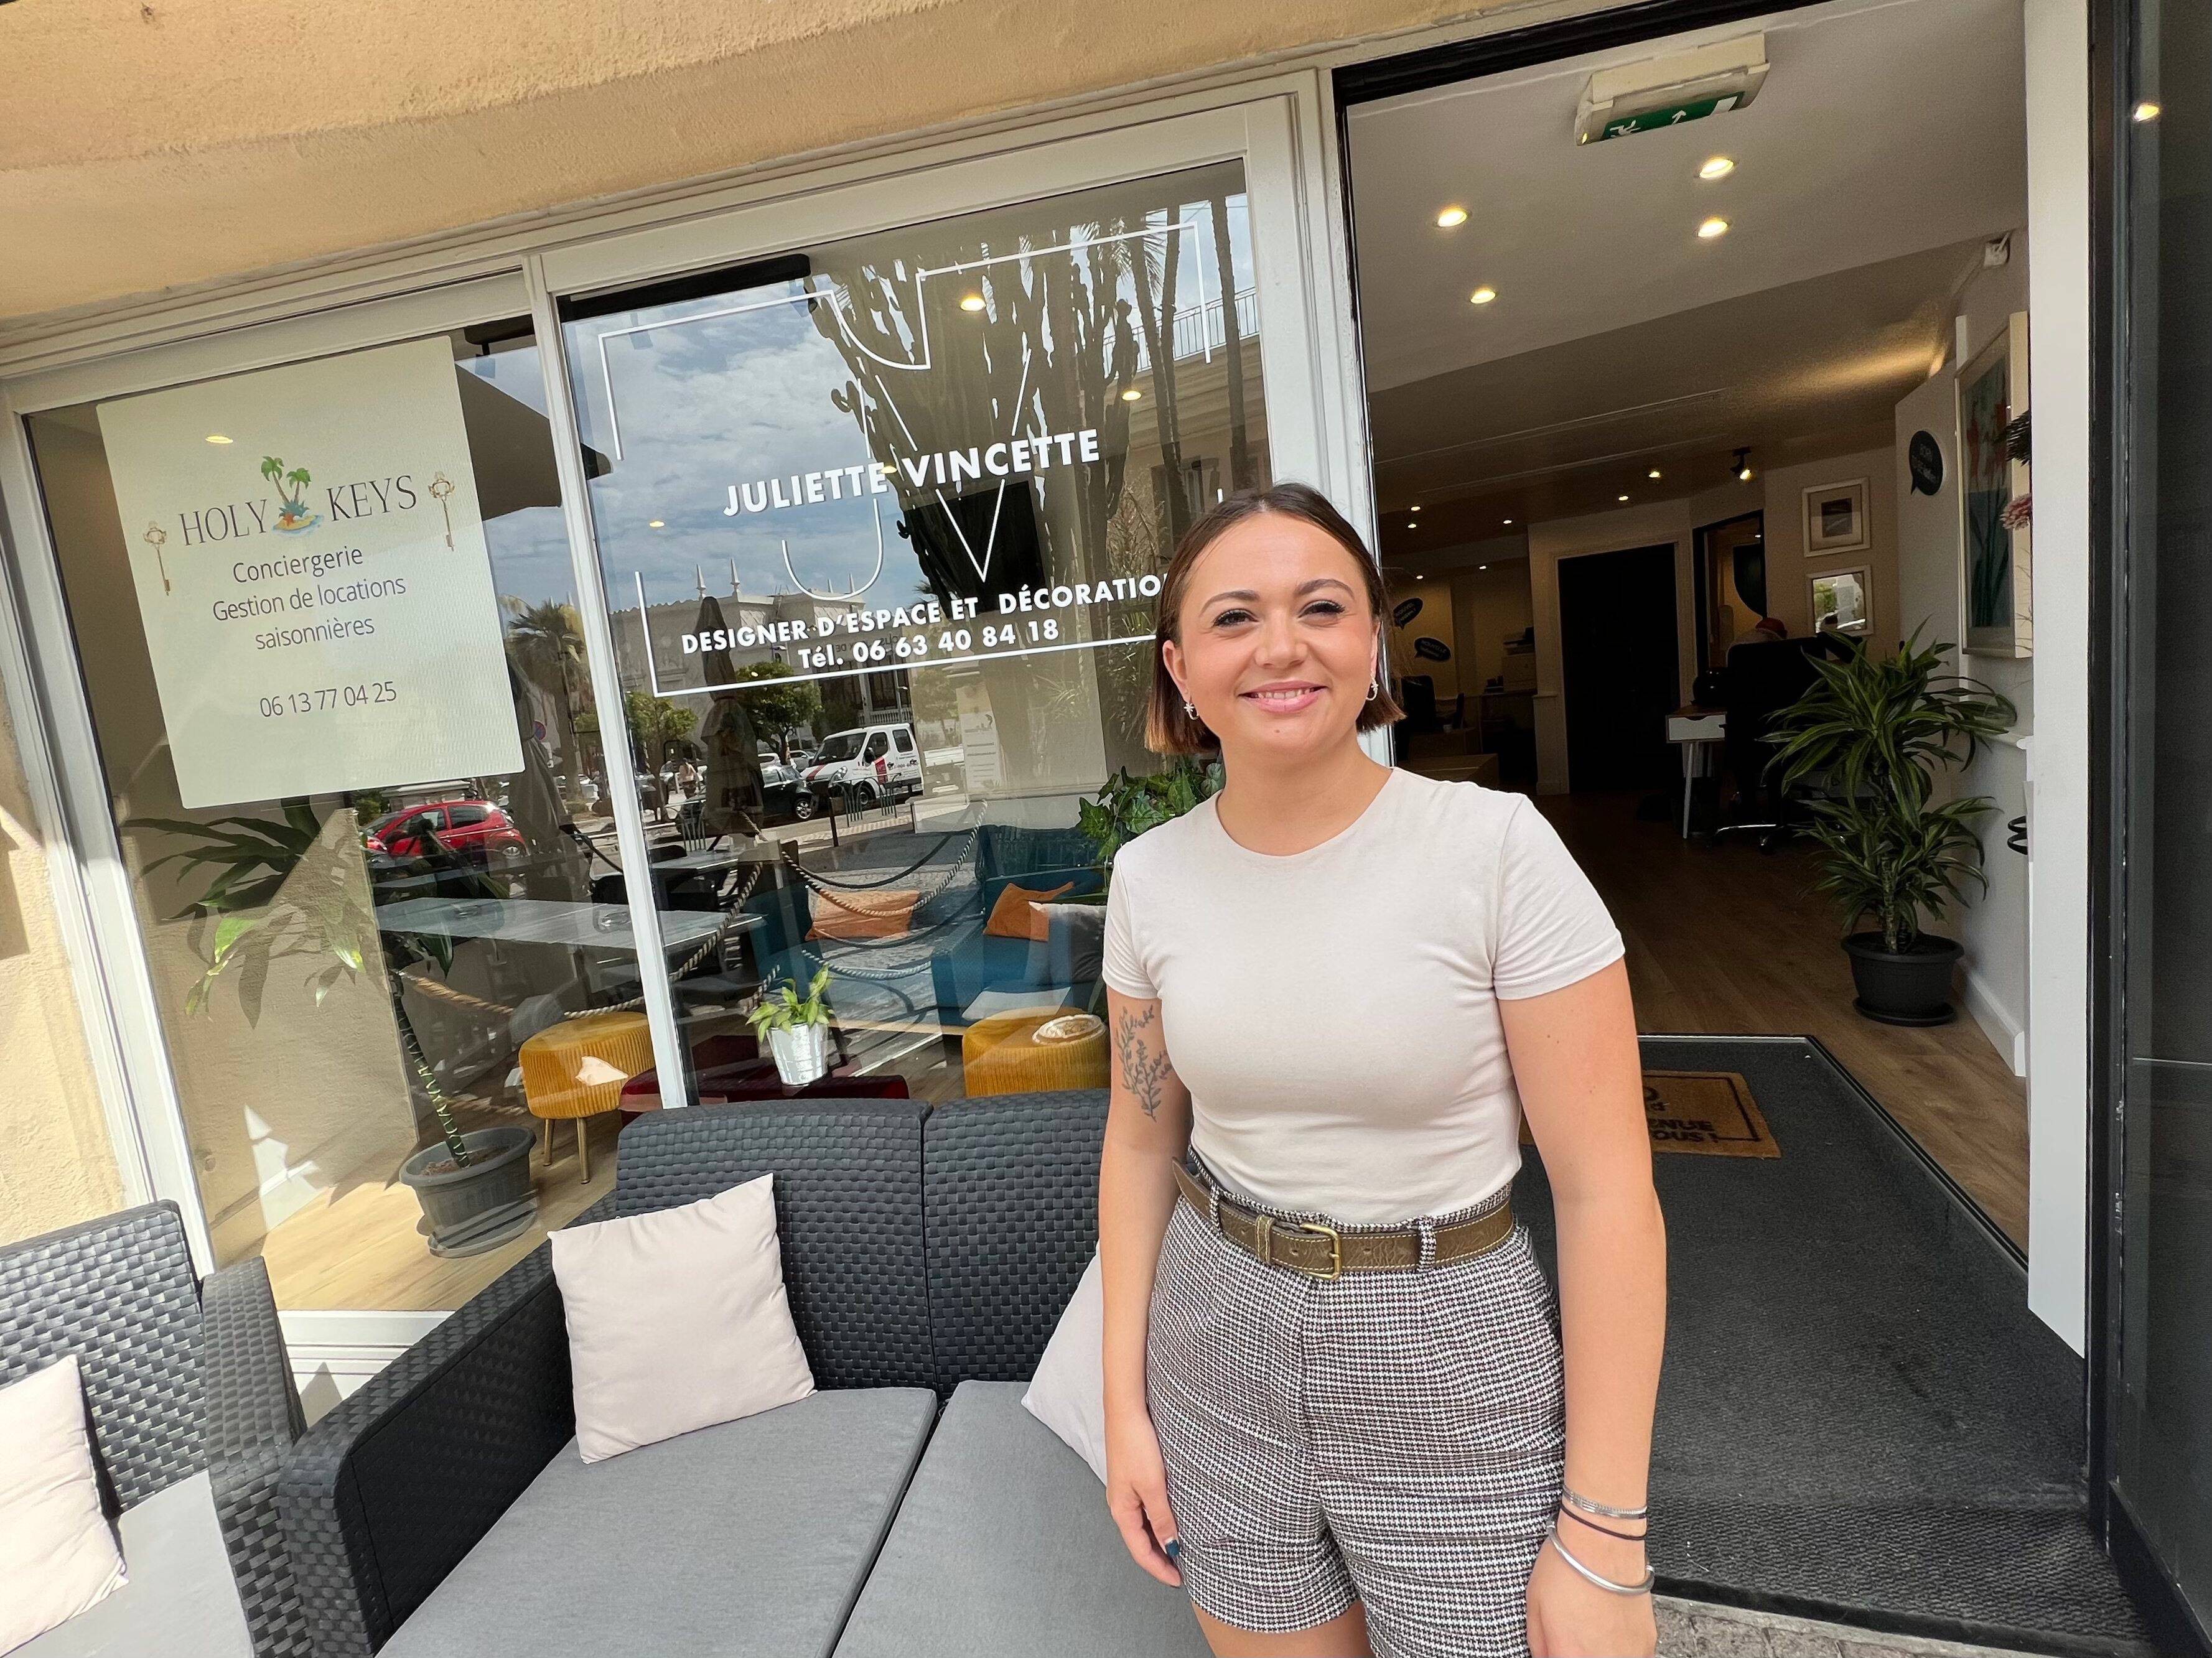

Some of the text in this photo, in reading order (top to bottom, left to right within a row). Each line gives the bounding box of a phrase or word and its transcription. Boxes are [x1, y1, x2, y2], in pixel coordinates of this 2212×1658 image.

[722, 429, 1099, 516] JULIETTE VINCETTE
[179, 475, 417, 546] HOLY KEYS
[233, 546, 363, 583] Conciergerie
[213, 578, 406, 621] Gestion de locations
[681, 620, 808, 654] DESIGNER
[951, 597, 978, 620] ET
[999, 573, 1167, 615] DÉCORATIO
[255, 617, 375, 650] saisonnières
[798, 645, 844, 669] Tél.
[852, 640, 885, 663] 06
[895, 635, 928, 658] 63
[938, 629, 972, 651] 40
[982, 624, 1016, 648] 84
[1028, 619, 1059, 641] 18
[260, 681, 397, 717] 06 13 77 04 25
